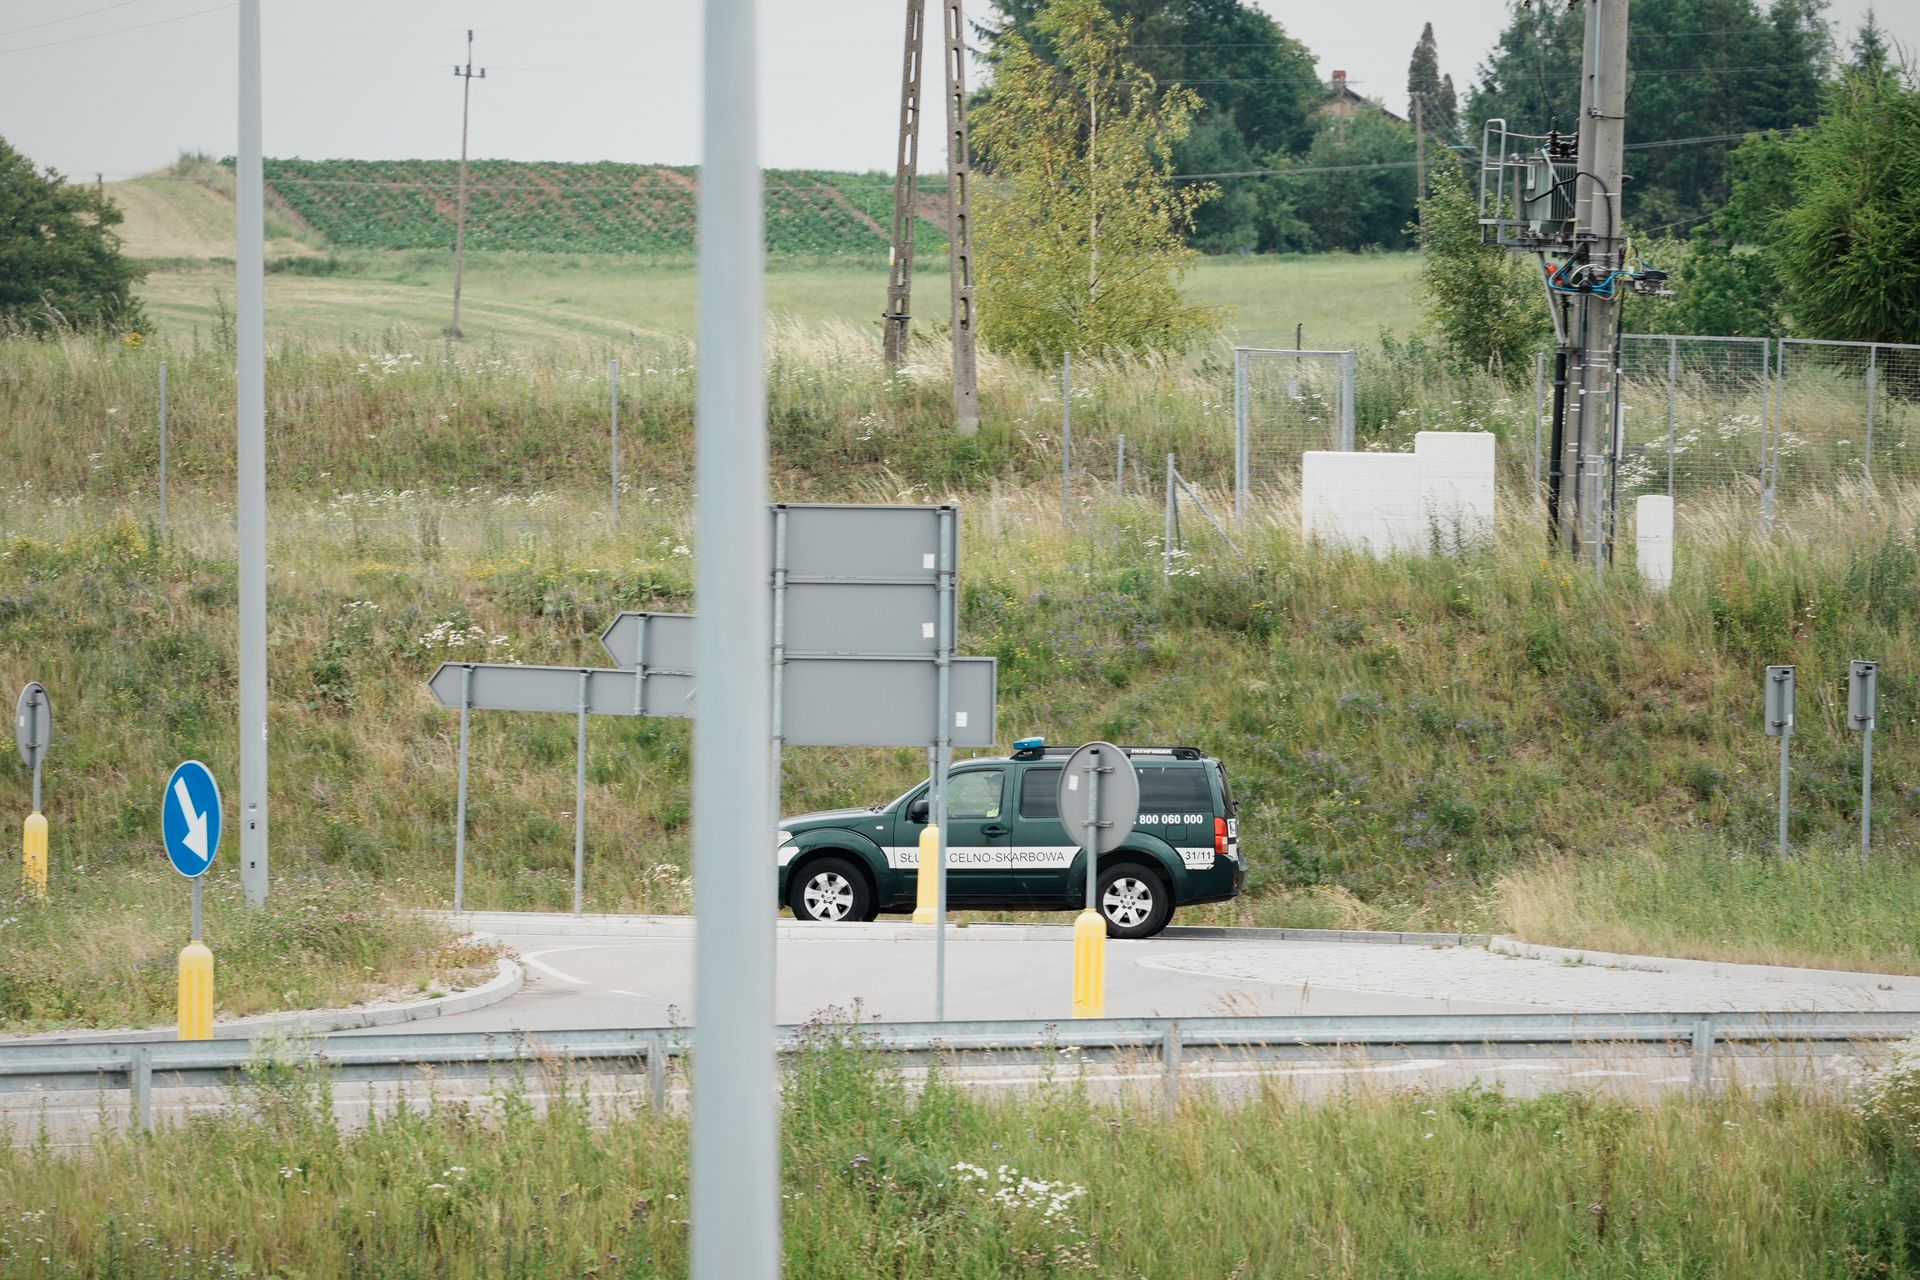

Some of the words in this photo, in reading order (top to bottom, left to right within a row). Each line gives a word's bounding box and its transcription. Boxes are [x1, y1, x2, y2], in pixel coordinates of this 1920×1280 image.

[1139, 814, 1159, 824] 800
[1161, 814, 1181, 824] 060
[1183, 814, 1203, 824] 000
[949, 852, 1065, 862] CELNO-SKARBOWA
